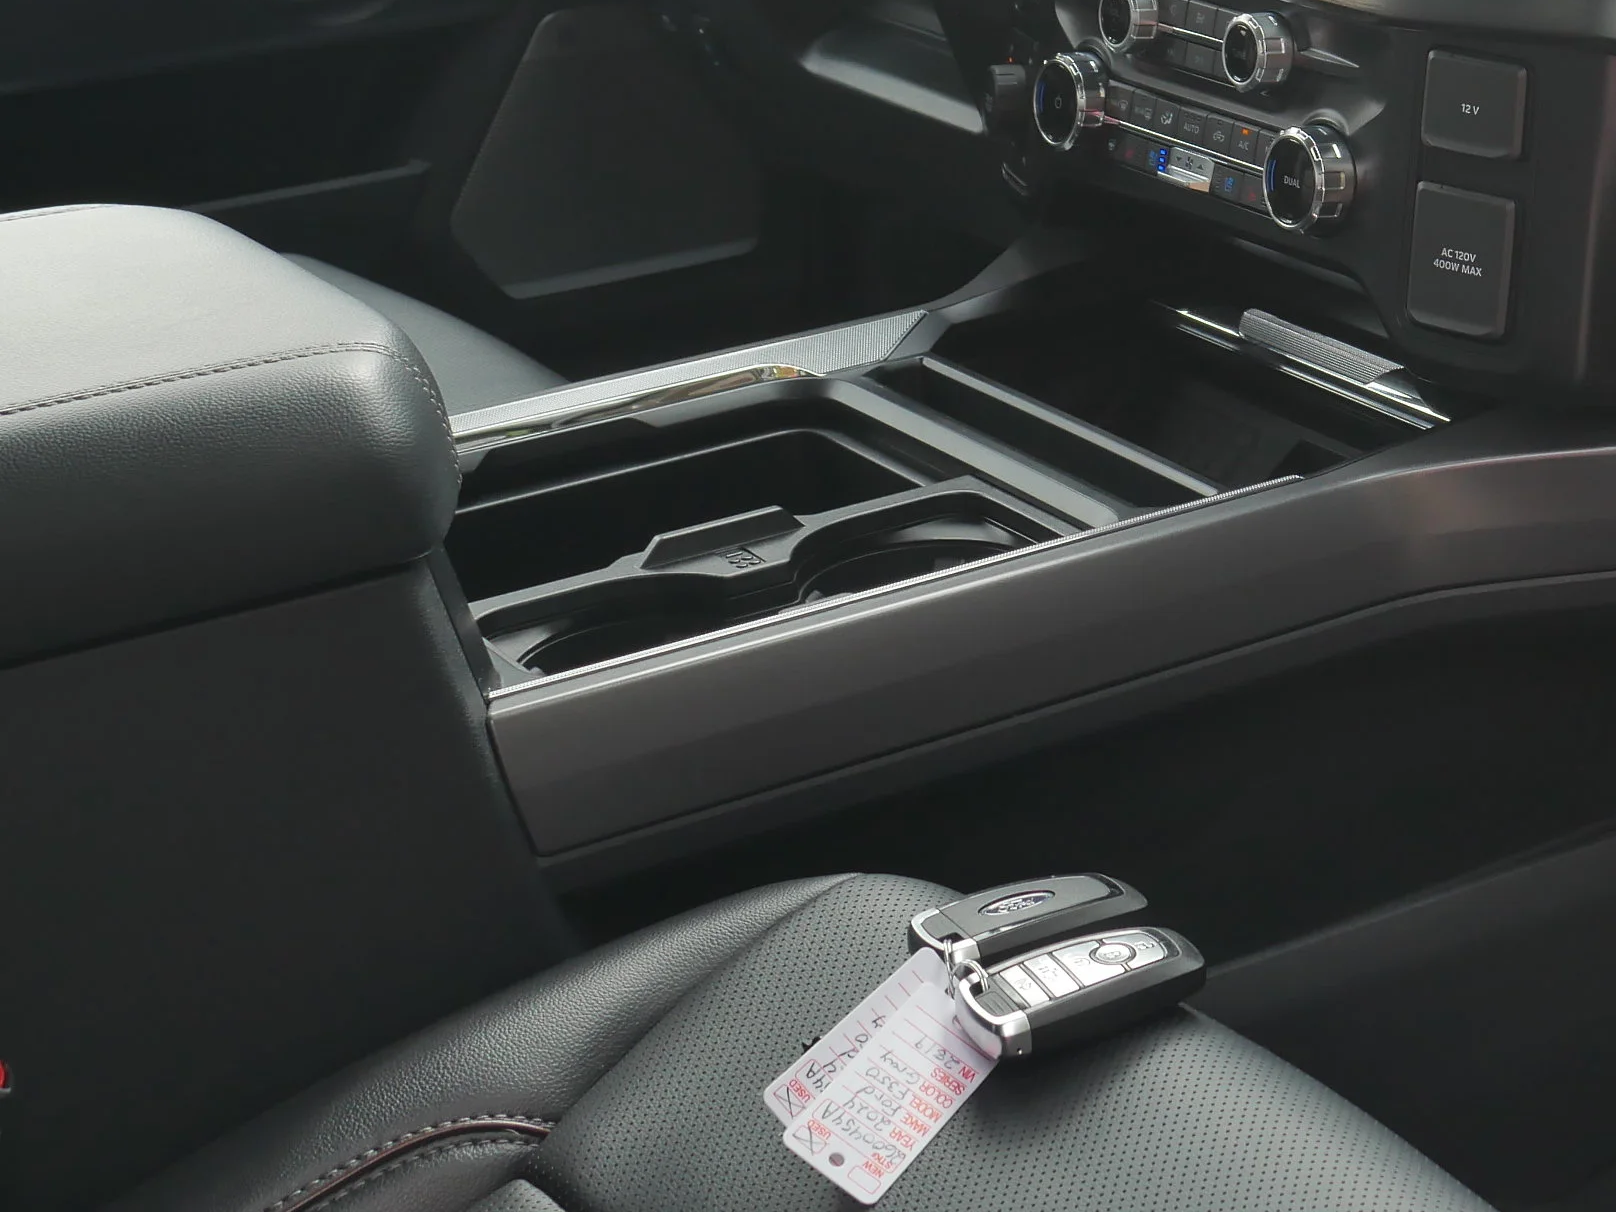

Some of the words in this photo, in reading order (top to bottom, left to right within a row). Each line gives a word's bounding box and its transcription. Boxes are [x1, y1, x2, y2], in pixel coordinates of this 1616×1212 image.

[1461, 103, 1471, 114] 12
[1473, 105, 1480, 115] V
[1184, 123, 1200, 134] AUTO
[1284, 176, 1300, 188] DUAL
[1441, 247, 1453, 258] AC
[1454, 250, 1476, 263] 120V
[1433, 259, 1460, 273] 400W
[1461, 265, 1482, 277] MAX
[866, 1068, 910, 1100] F350
[930, 1067, 965, 1095] SERIES
[959, 1066, 976, 1083] VIN
[789, 1079, 810, 1103] USED
[857, 1086, 901, 1116] Ford
[919, 1082, 953, 1109] COLOR
[844, 1095, 891, 1131] 2024
[909, 1095, 942, 1123] MODEL
[807, 1120, 832, 1140] USED
[901, 1112, 930, 1137] MAKE
[890, 1129, 916, 1151] YEAR
[863, 1161, 884, 1178] NEW
